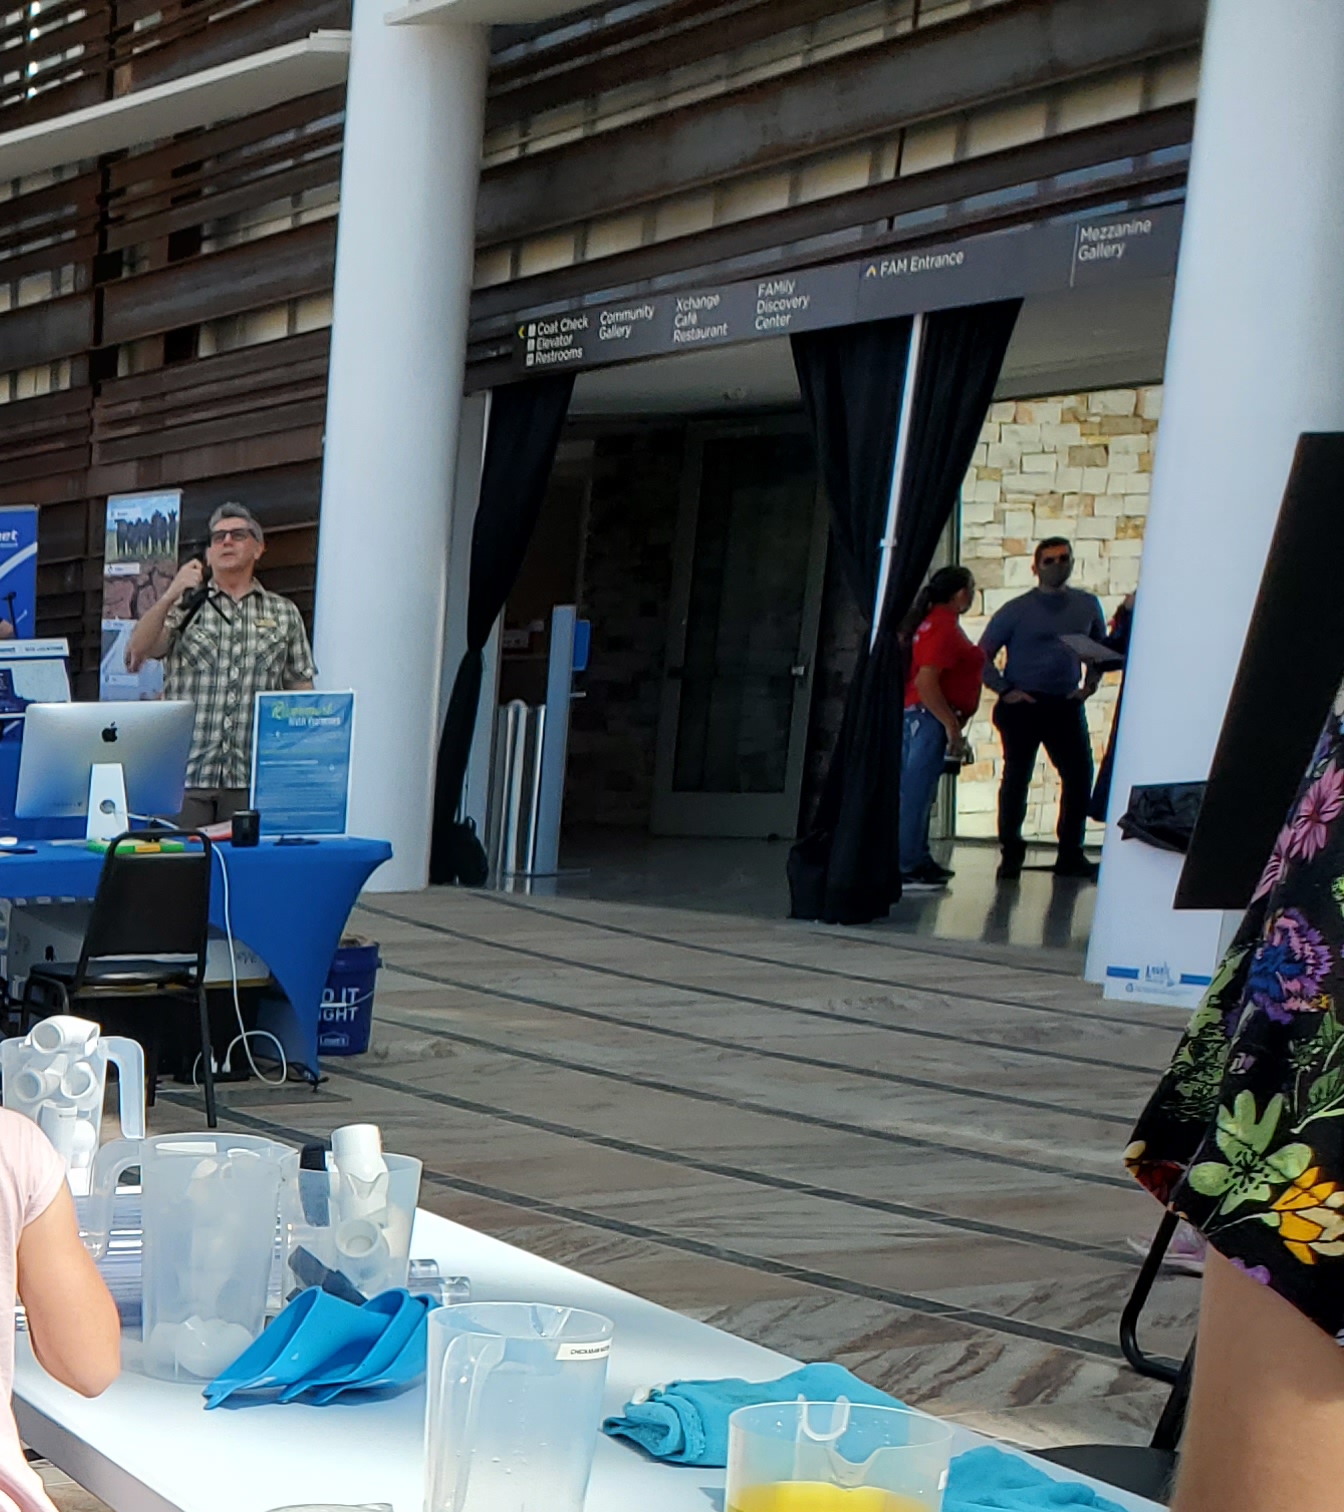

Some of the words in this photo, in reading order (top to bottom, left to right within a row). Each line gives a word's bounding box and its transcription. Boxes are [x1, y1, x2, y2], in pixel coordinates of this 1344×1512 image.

[1080, 218, 1152, 243] Mezzanine
[1078, 243, 1126, 262] Gallery
[880, 258, 908, 278] FAM
[910, 250, 965, 272] Entrance
[758, 279, 797, 298] FAMily
[676, 293, 721, 313] Xchange
[756, 295, 811, 315] Discovery
[599, 304, 655, 326] Community
[674, 311, 698, 328] Café
[754, 313, 792, 331] Center
[537, 321, 558, 336] Coat
[560, 315, 589, 331] Check
[598, 323, 632, 340] Gallery
[673, 322, 729, 343] Restaurant
[536, 333, 574, 350] Elevator
[534, 346, 584, 364] Restrooms
[318, 1007, 359, 1022] IGHT
